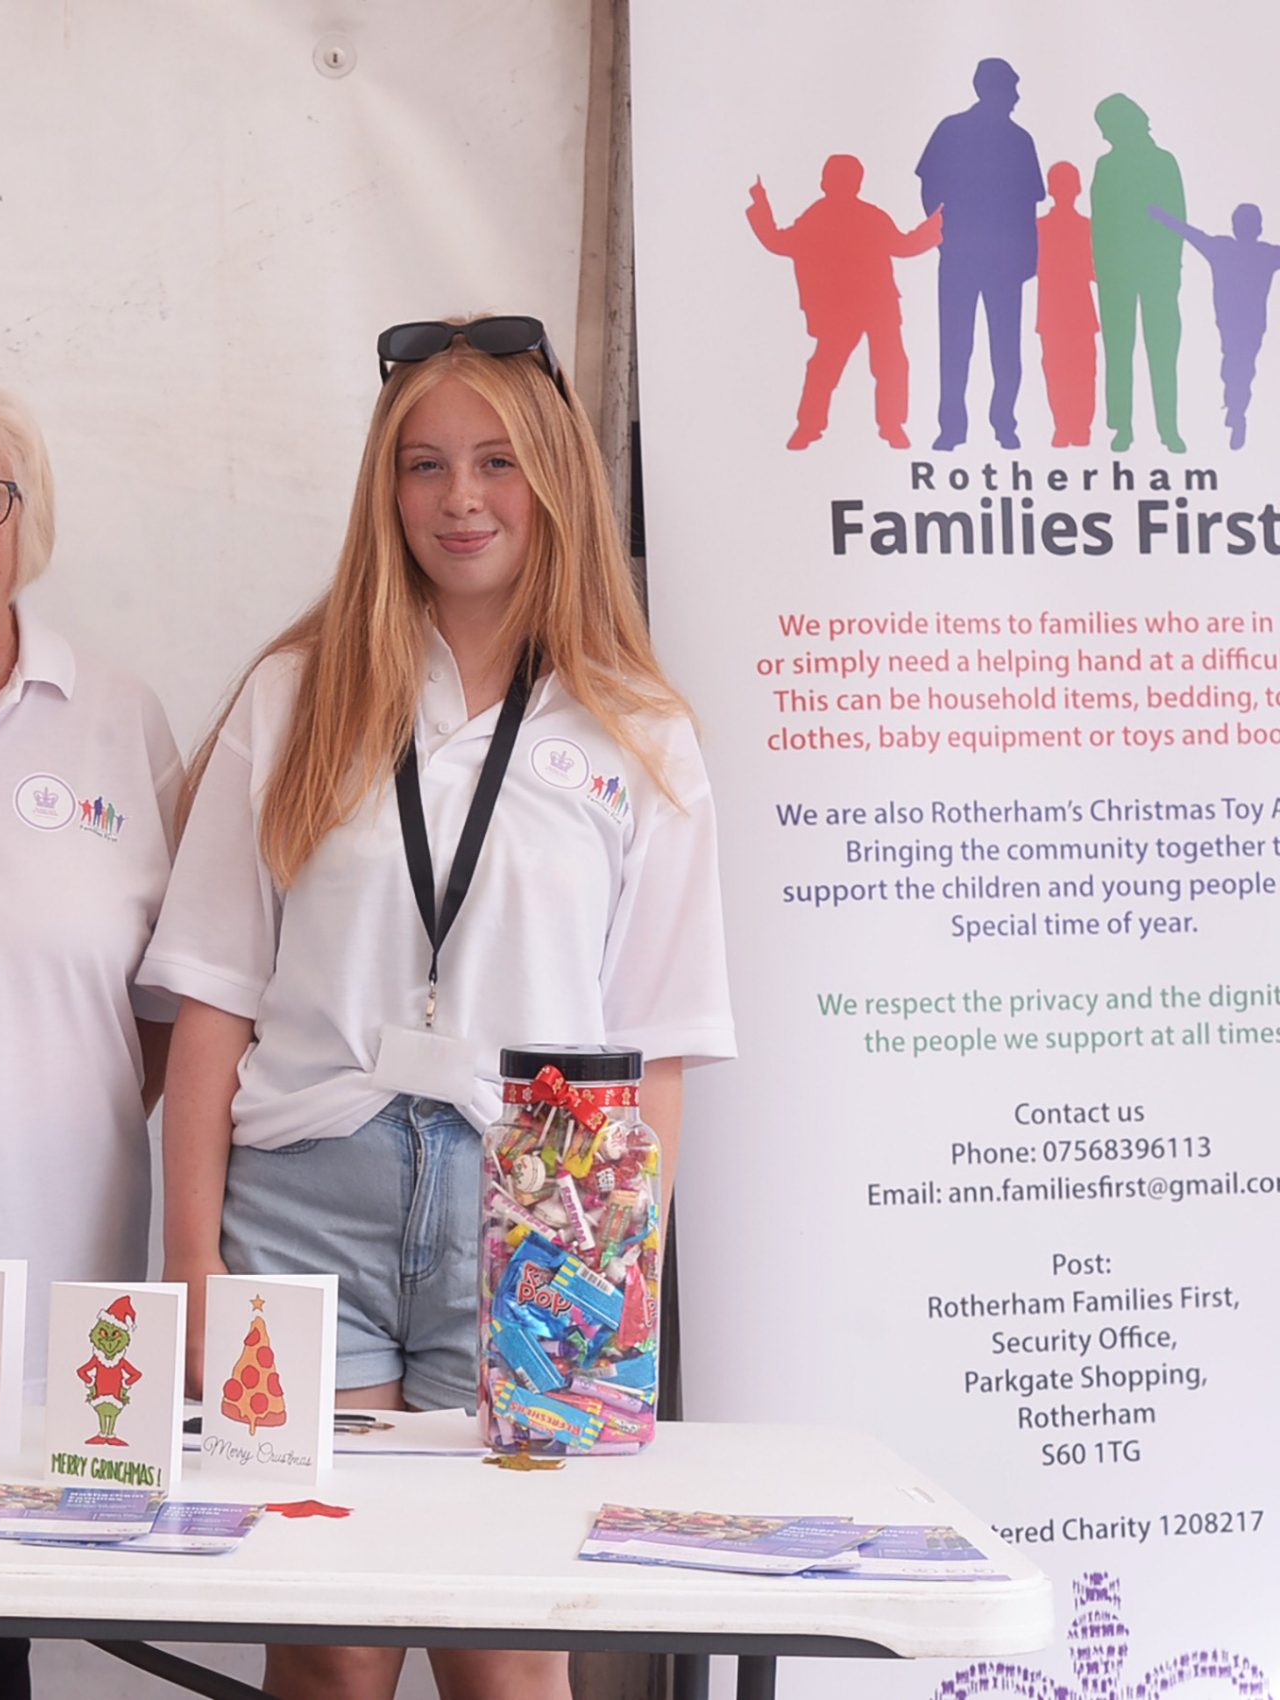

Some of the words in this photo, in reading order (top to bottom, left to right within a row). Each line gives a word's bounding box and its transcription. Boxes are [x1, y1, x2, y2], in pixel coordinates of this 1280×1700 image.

[910, 460, 1219, 492] Rotherham
[830, 495, 1115, 557] Families
[1136, 496, 1280, 557] First
[778, 613, 821, 637] We
[828, 610, 929, 642] provide
[935, 611, 1001, 635] items
[1007, 614, 1033, 635] to
[1039, 610, 1138, 635] families
[1144, 610, 1200, 634] who
[1206, 616, 1245, 634] are
[1252, 611, 1273, 633] in
[756, 658, 785, 676] or
[792, 649, 881, 679] simply
[888, 648, 950, 673] need
[956, 655, 970, 673] a
[977, 648, 1070, 679] helping
[1077, 647, 1142, 672] hand
[1149, 651, 1174, 671] at
[1180, 654, 1194, 671] a
[1201, 646, 1280, 671] difficu
[772, 688, 829, 713] This
[836, 693, 882, 712] can
[889, 686, 921, 711] be
[928, 686, 1056, 710] household
[1064, 687, 1139, 712] items,
[1147, 684, 1258, 714] bedding,
[767, 725, 871, 752] clothes,
[879, 724, 941, 754] baby
[947, 724, 1082, 754] equipment
[1089, 730, 1116, 747] or
[1121, 726, 1175, 753] toys
[1181, 722, 1229, 746] and
[775, 803, 818, 827] We
[825, 807, 867, 826] are
[874, 800, 924, 825] also
[1089, 798, 1216, 822] Christmas
[1220, 797, 1264, 826] Toy
[846, 839, 953, 869] Bringing
[960, 837, 1000, 862] the
[1006, 836, 1149, 865] community
[1155, 834, 1266, 865] together
[783, 879, 888, 908] support
[894, 876, 936, 901] the
[941, 875, 1041, 900] children
[1048, 873, 1094, 898] and
[1101, 879, 1181, 904] young
[1189, 870, 1277, 902] people
[951, 912, 1037, 943] Special
[1043, 912, 1100, 936] time
[1106, 910, 1133, 935] of
[1138, 915, 1199, 941] year.
[817, 993, 858, 1016] We
[865, 993, 956, 1021] respect
[962, 989, 1003, 1013] the
[1009, 988, 1099, 1018] privacy
[1106, 985, 1153, 1010] and
[1160, 985, 1202, 1009] the
[864, 1029, 905, 1054] the
[912, 1027, 997, 1058] people
[1003, 1032, 1039, 1050] we
[1045, 1026, 1144, 1054] support
[1151, 1026, 1175, 1046] at
[1181, 1021, 1210, 1046] all
[1014, 1102, 1111, 1126] Contact
[1117, 1105, 1145, 1123] us
[951, 1141, 1037, 1166] Phone:
[1042, 1135, 1213, 1163] 07568396113
[867, 1180, 942, 1206] Email:
[1052, 1253, 1112, 1276] Post:
[927, 1291, 1065, 1319] Rotherham
[1072, 1287, 1174, 1313] Families
[1180, 1285, 1240, 1311] First,
[991, 1328, 1092, 1358] Security
[1098, 1324, 1177, 1351] Office,
[964, 1368, 1074, 1398] Parkgate
[1080, 1362, 1208, 1393] Shopping,
[1018, 1402, 1156, 1430] Rotherham
[51, 1452, 88, 1477] MERRY
[202, 1435, 255, 1466] Merry
[1041, 1442, 1087, 1467] S60
[1094, 1439, 1141, 1464] 1TG
[1061, 1515, 1152, 1544] Charity
[1159, 1509, 1264, 1537] 1208217
